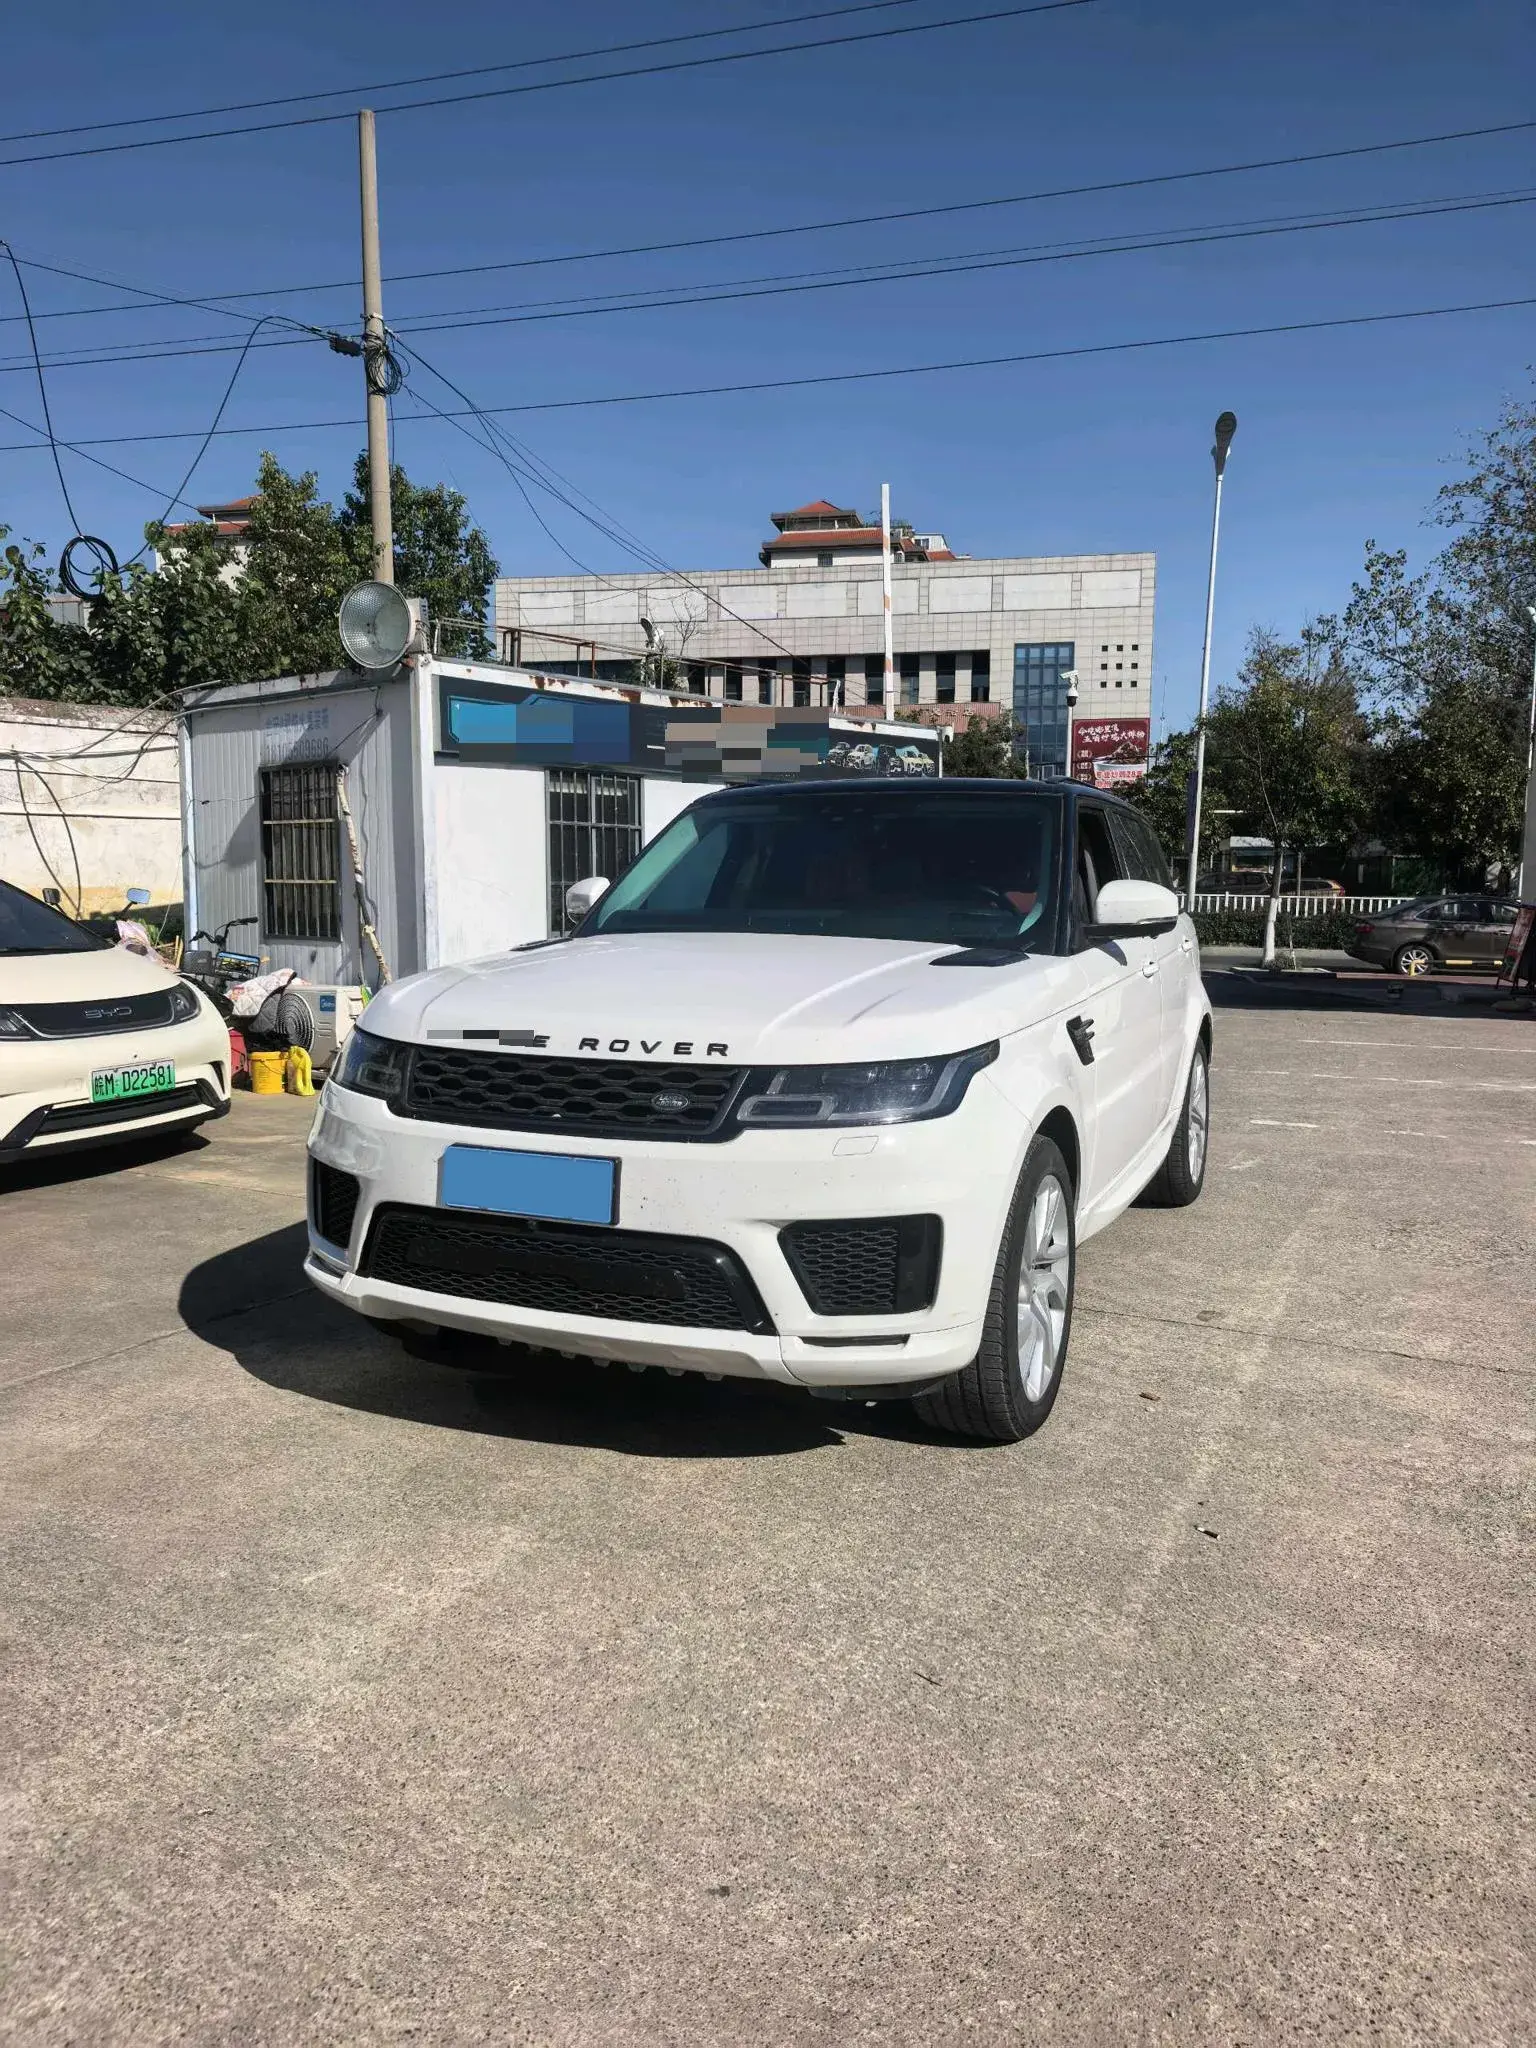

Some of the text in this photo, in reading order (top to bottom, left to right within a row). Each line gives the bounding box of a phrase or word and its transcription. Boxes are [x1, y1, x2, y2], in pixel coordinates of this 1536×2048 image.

[85, 1006, 132, 1019] BYD
[579, 1037, 729, 1057] ROVER
[122, 1064, 173, 1093] D22581
